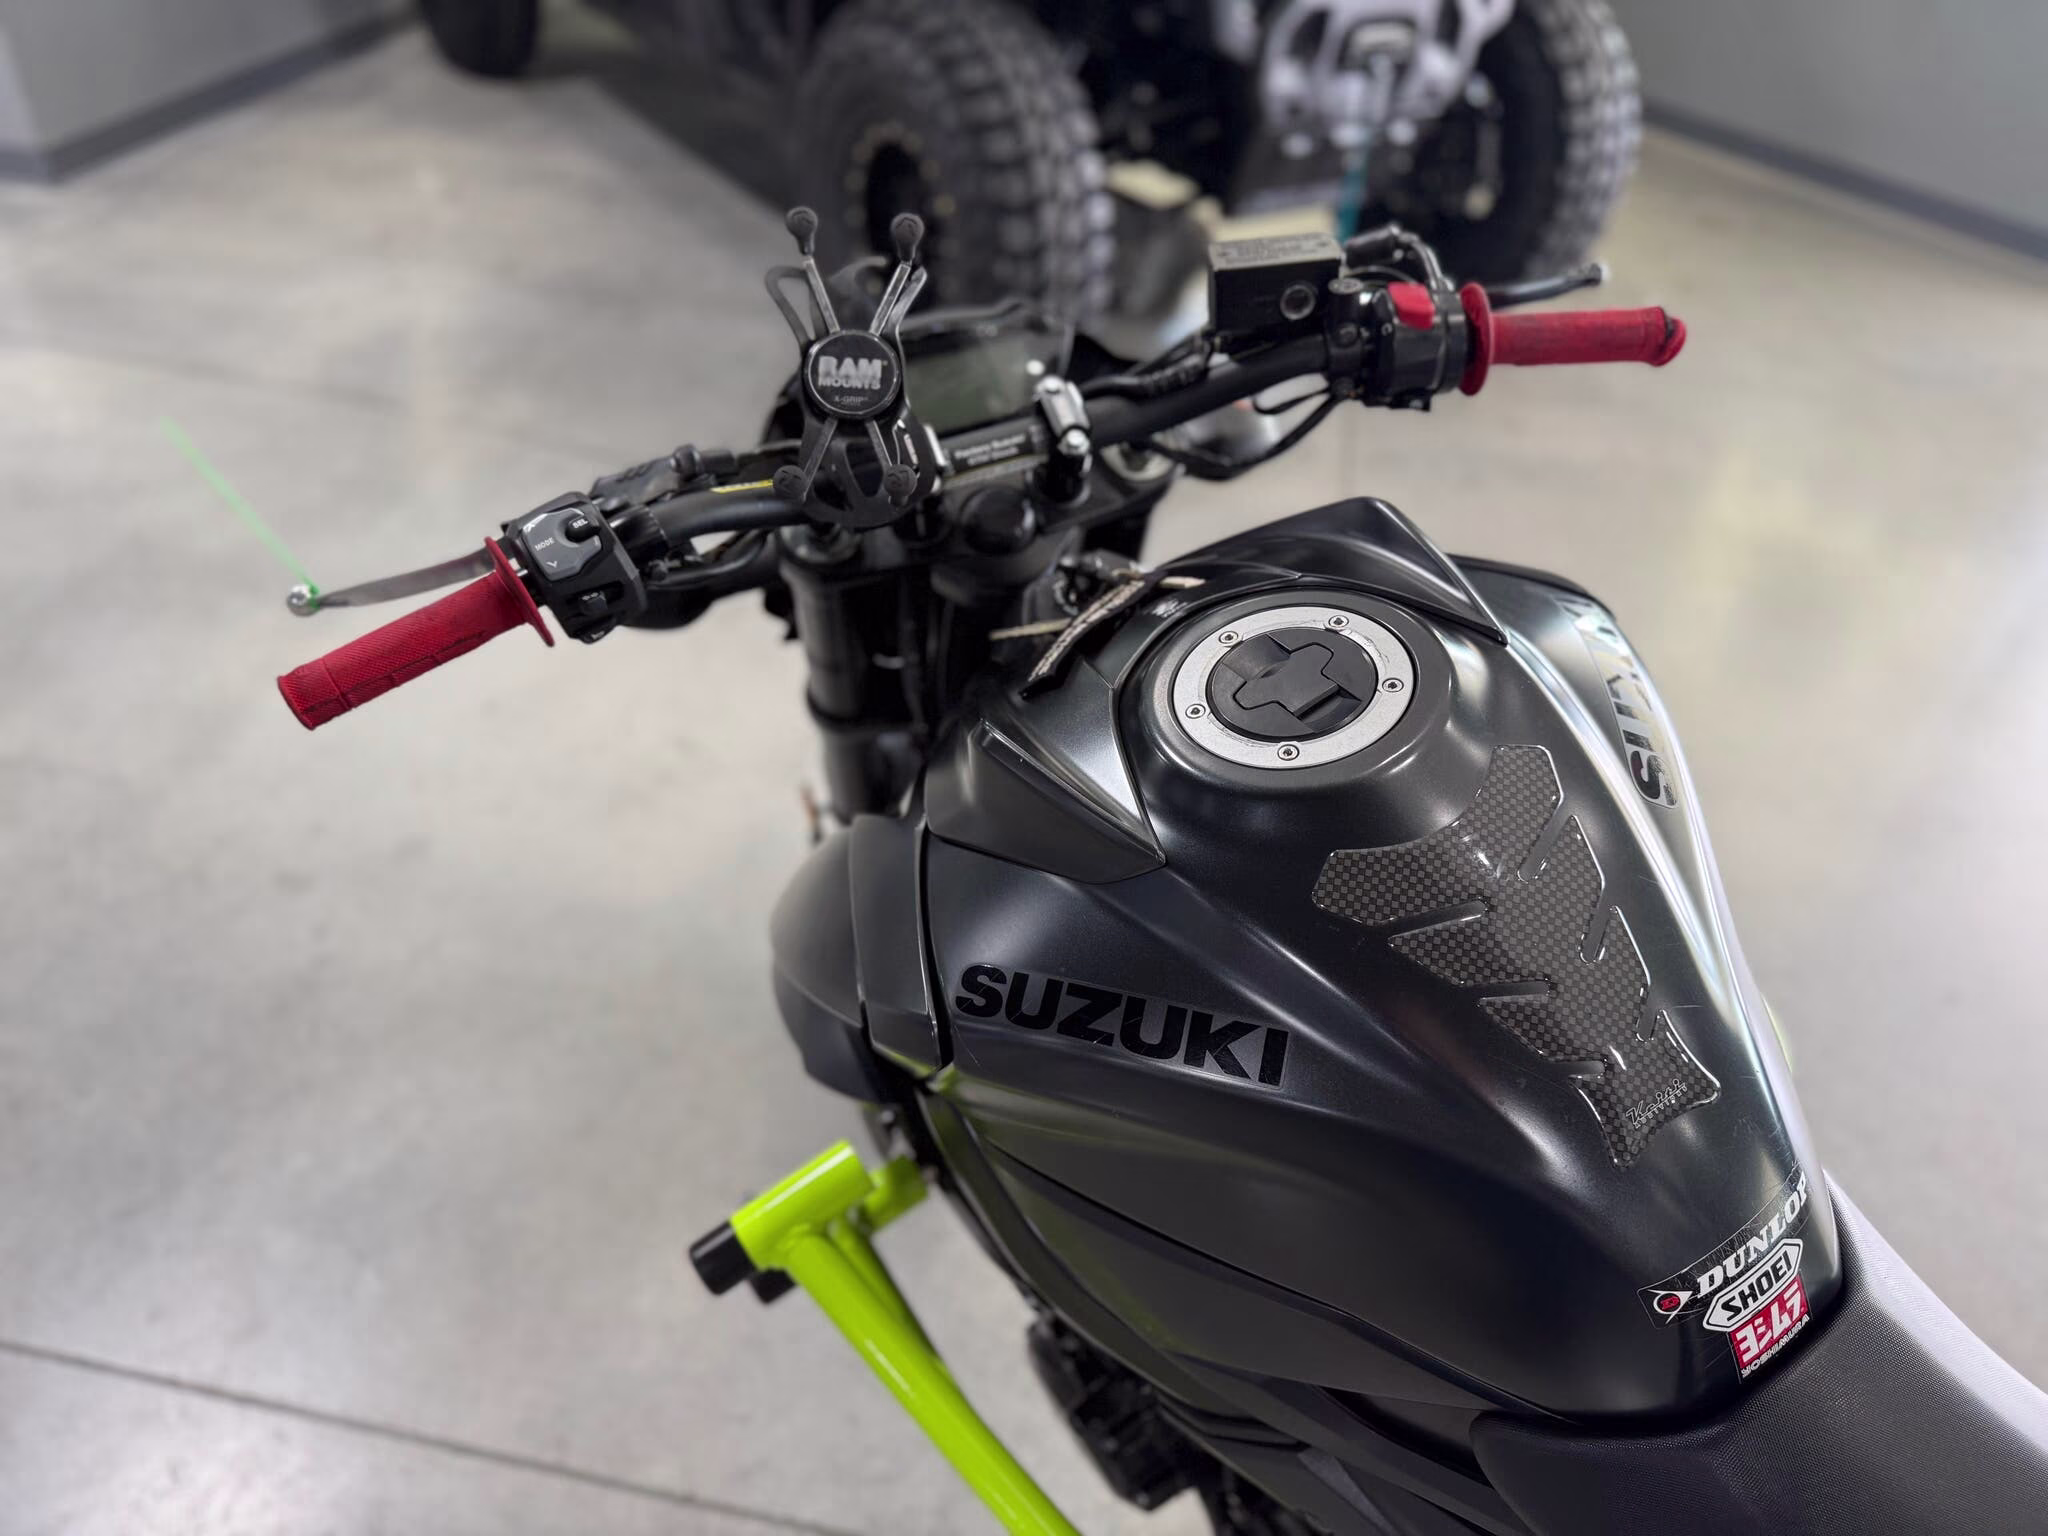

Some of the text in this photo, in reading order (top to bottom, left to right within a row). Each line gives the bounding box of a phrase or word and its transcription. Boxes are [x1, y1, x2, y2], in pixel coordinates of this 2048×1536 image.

[818, 356, 882, 378] RAM
[818, 376, 881, 390] MOUNTS
[534, 537, 555, 551] MODE
[572, 518, 588, 529] SEL
[955, 964, 1290, 1087] SUZUKI
[1697, 1170, 1807, 1299] DUNLOP
[1721, 1250, 1793, 1322] SHOEI
[1740, 1313, 1811, 1379] YOSHIMURA
